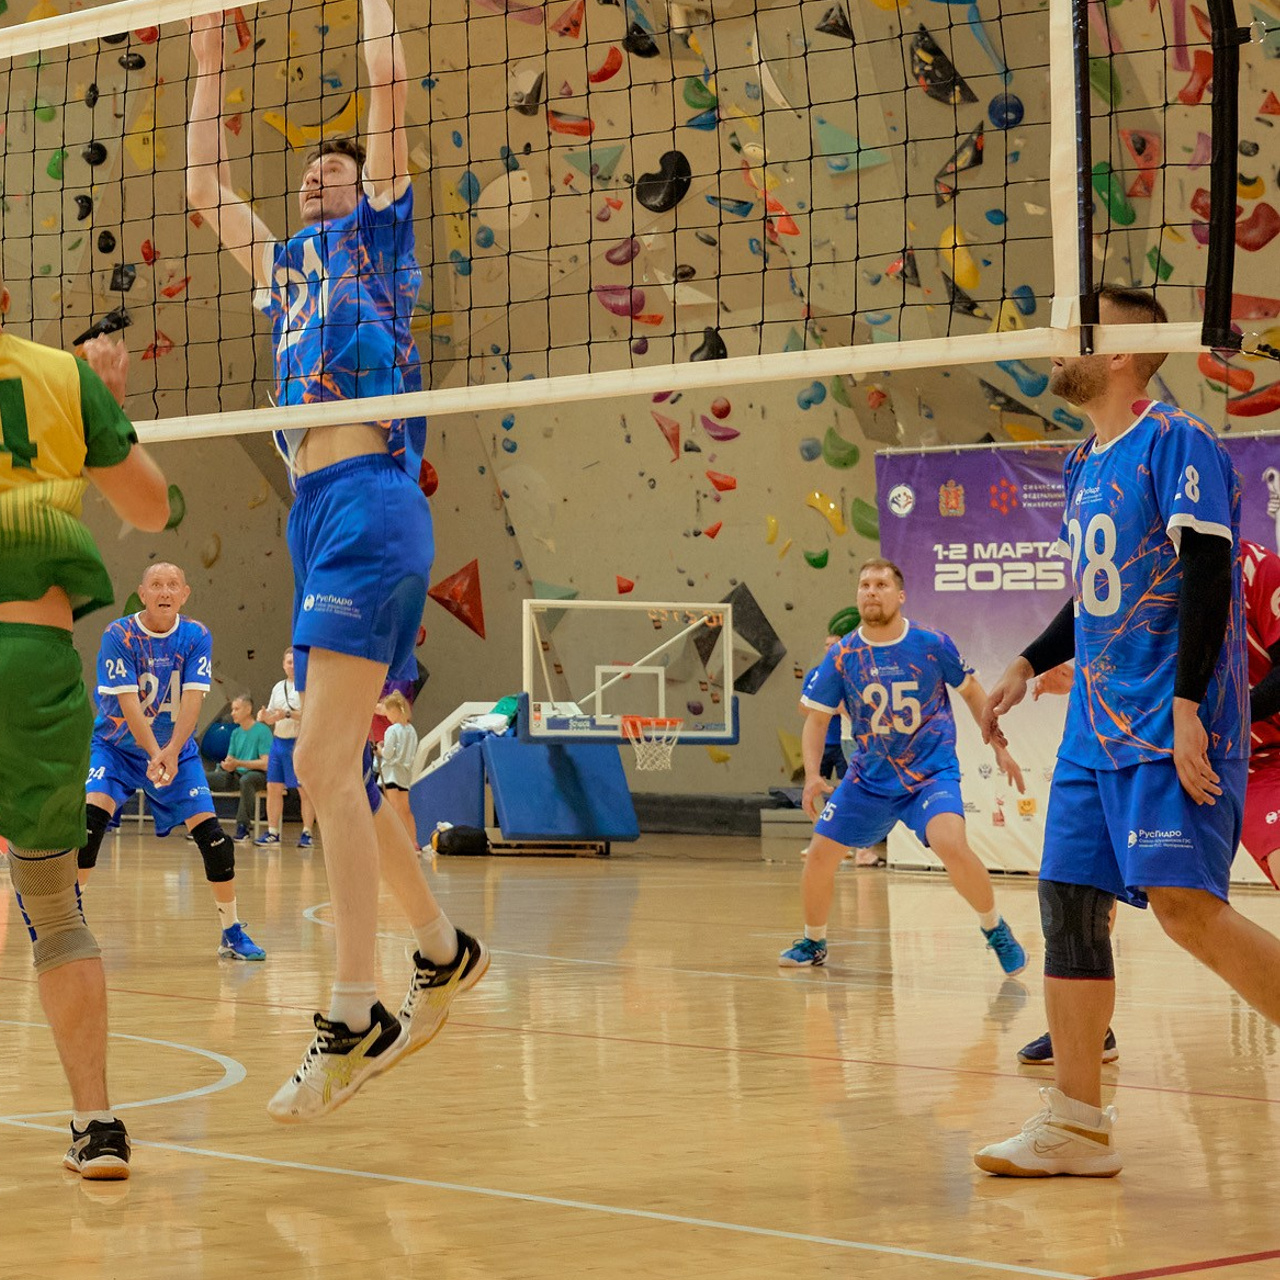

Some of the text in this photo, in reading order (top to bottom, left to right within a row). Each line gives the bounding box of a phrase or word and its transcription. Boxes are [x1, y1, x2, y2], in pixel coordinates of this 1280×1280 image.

[274, 237, 329, 355] 21
[1175, 464, 1200, 503] 8
[933, 541, 1061, 560] 1-2 МАРТА
[934, 562, 1066, 591] 2025
[105, 658, 128, 680] 24
[140, 670, 182, 725] 24
[863, 681, 921, 735] 25
[1139, 829, 1182, 838] РусГидро
